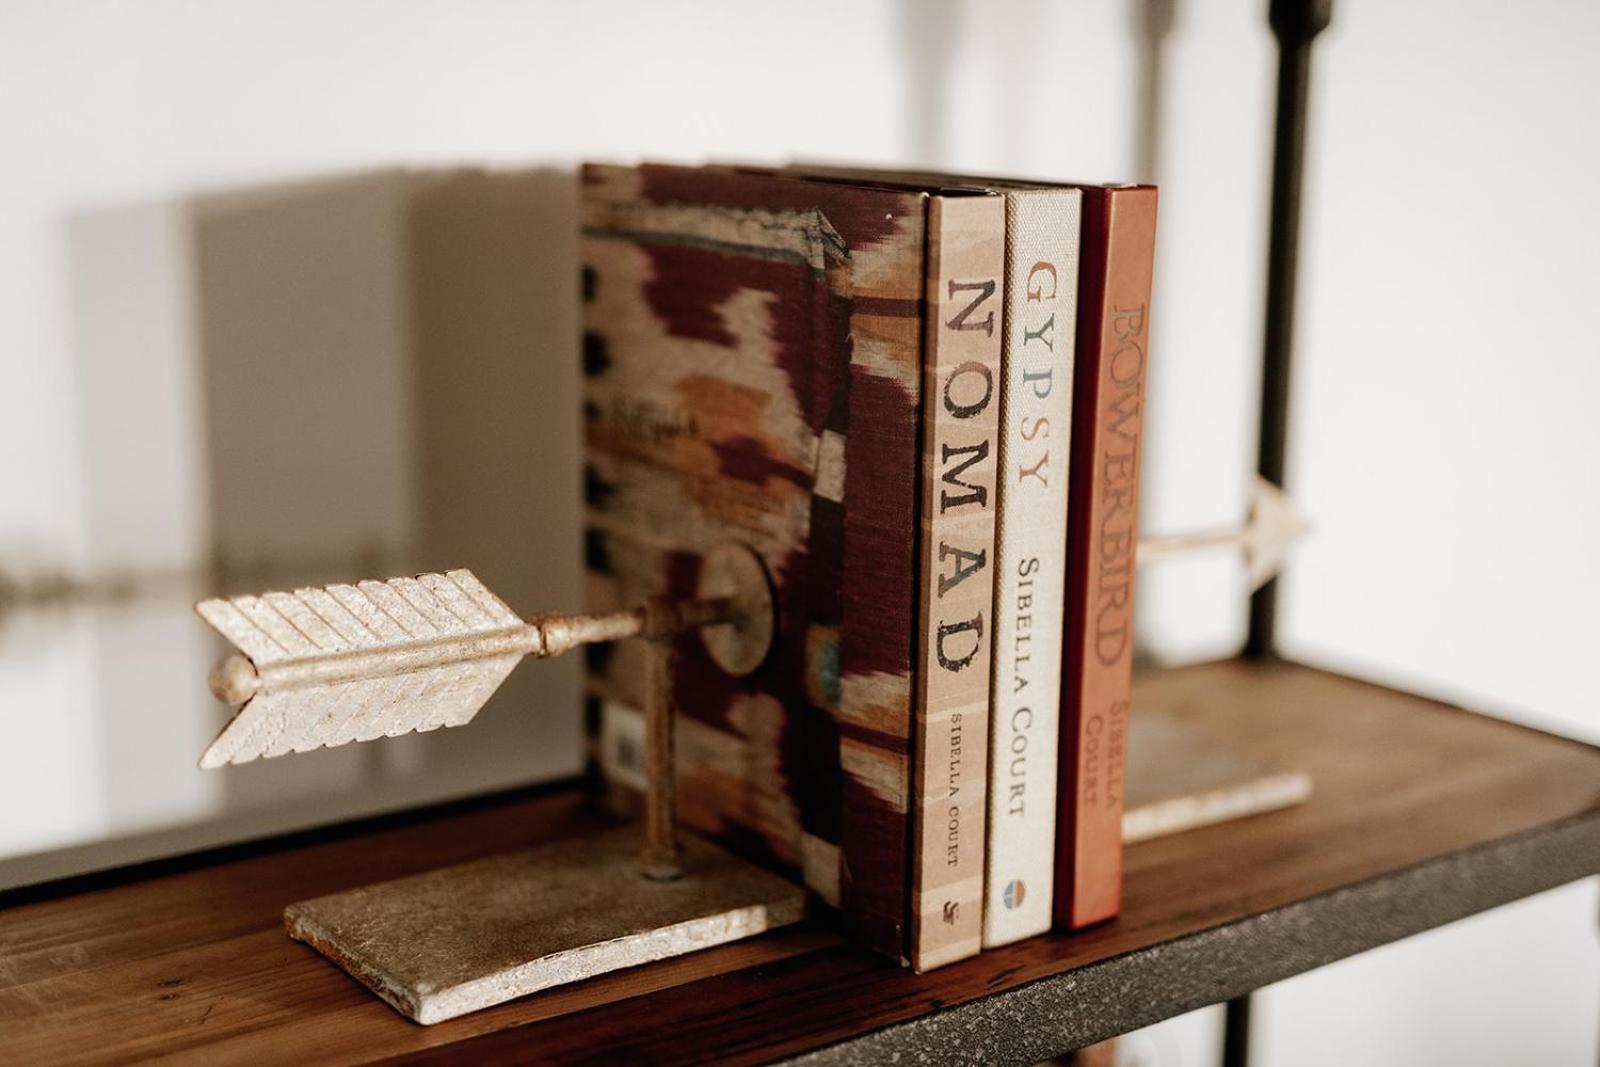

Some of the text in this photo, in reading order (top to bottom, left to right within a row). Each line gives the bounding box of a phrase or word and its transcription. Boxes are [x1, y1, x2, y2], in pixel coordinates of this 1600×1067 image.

[936, 278, 996, 673] NOMAD
[1018, 260, 1058, 488] GYPSY
[1095, 303, 1144, 667] BOWERBIRD
[947, 713, 962, 867] SIBELLA COURT
[1008, 557, 1040, 818] SIBELLA COURT
[1084, 715, 1103, 806] COURT
[1108, 702, 1126, 809] SIBELLA
